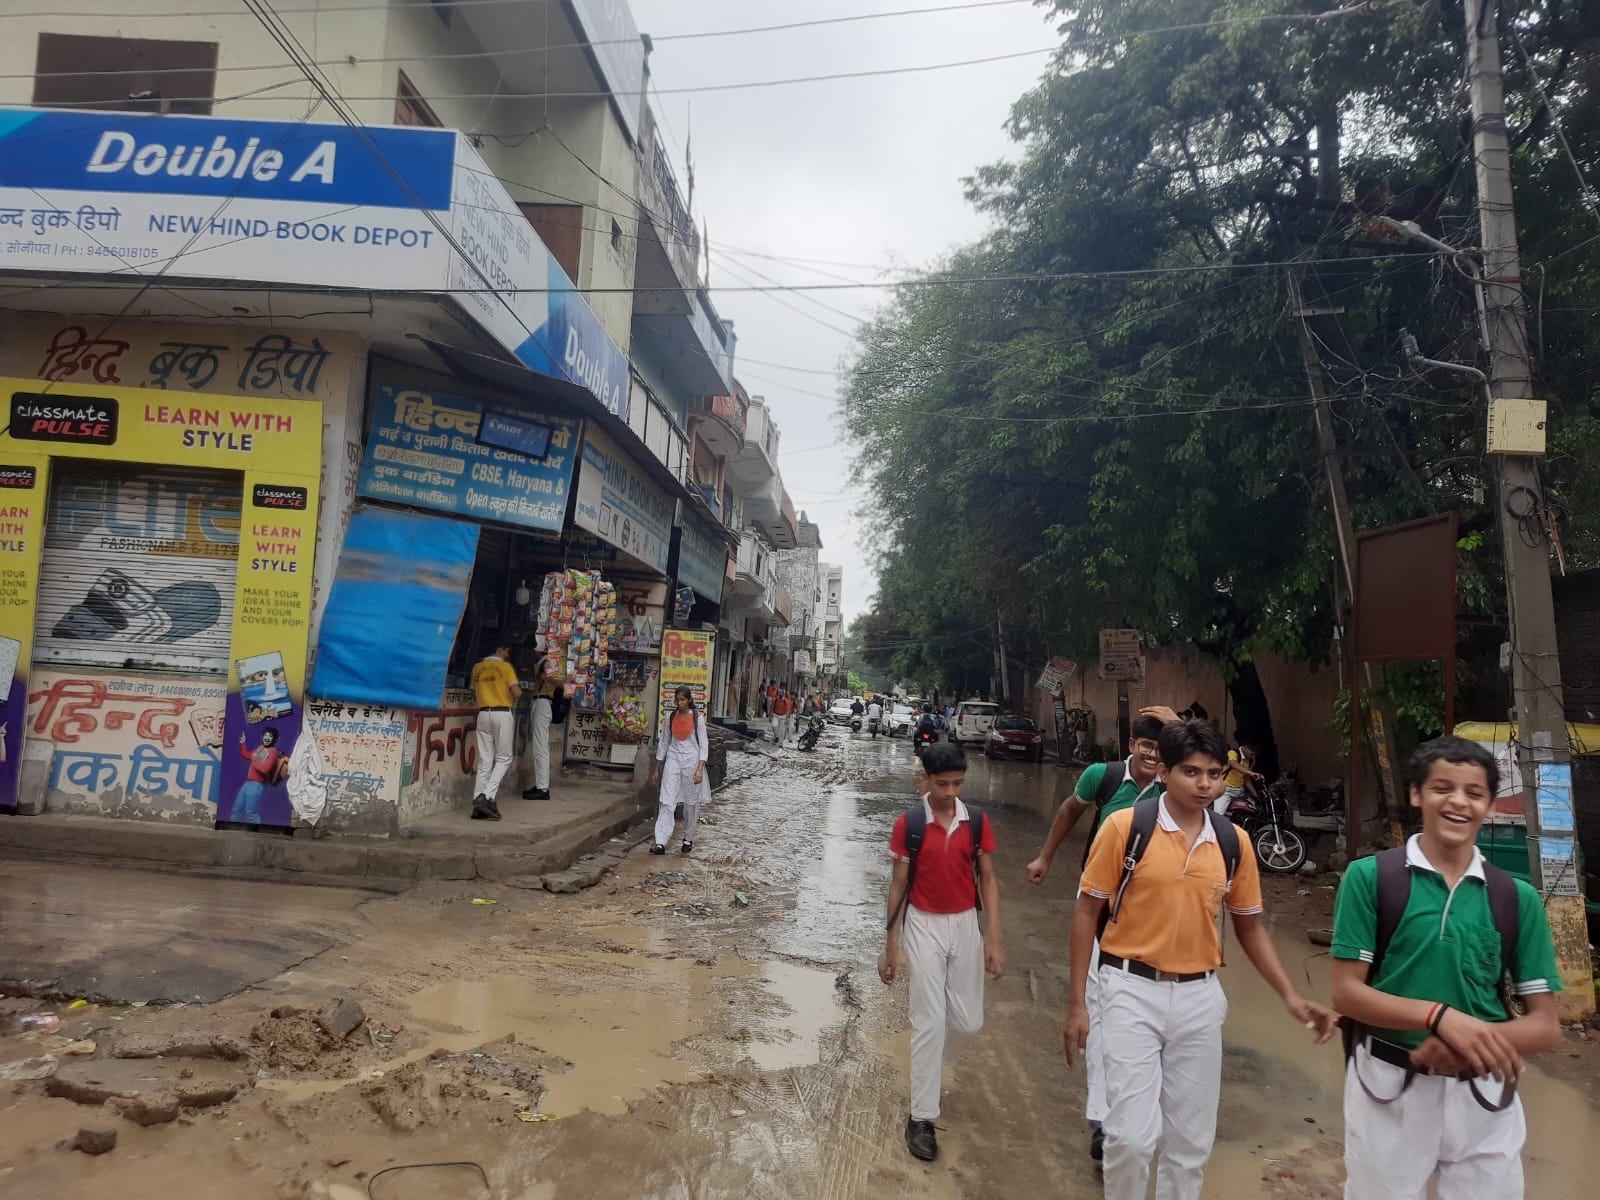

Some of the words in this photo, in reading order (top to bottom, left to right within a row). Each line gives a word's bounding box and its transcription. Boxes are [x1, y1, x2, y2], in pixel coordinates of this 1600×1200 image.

[87, 130, 283, 182] Double
[290, 141, 337, 184] A
[0, 207, 26, 228] न्द
[31, 209, 72, 235] बुक
[76, 205, 122, 231] डिपो
[148, 214, 204, 234] NEW
[209, 216, 269, 238] HIND
[276, 220, 347, 243] BOOK
[353, 226, 434, 249] DEPOT
[464, 200, 486, 237] NEW
[487, 226, 508, 264] HIND
[87, 246, 158, 259] 9466018105
[461, 227, 488, 272] BOOK
[491, 259, 517, 302] DEPOT
[38, 326, 130, 383] हिन्द
[238, 333, 331, 394] डिपो
[564, 326, 610, 406] Double
[144, 405, 221, 427] LEARN
[230, 411, 293, 433] WITH
[394, 390, 482, 437] हिन्द
[31, 419, 109, 438] PULSE
[497, 423, 522, 435] PILOT
[182, 430, 253, 452] STYLE
[472, 462, 504, 488] CBSE,
[507, 468, 552, 494] Haryana
[556, 477, 565, 496] &
[603, 452, 627, 495] HIND
[629, 474, 651, 515] BOOK
[264, 498, 303, 507] PULSE
[466, 487, 489, 510] Open
[252, 524, 302, 538] LEARN
[256, 541, 296, 555] WITH
[252, 558, 297, 573] STYLE
[0, 588, 18, 596] OUR
[243, 588, 272, 597] MAKE
[274, 590, 299, 599] YOUR
[242, 598, 271, 607] IDEAS
[274, 599, 301, 609] SHINE
[242, 607, 263, 616] AND
[266, 608, 292, 617] YOUR
[241, 616, 279, 626] COVERS
[29, 679, 196, 748] हिन्द
[575, 713, 596, 728] बुक
[126, 743, 221, 804] डिपो
